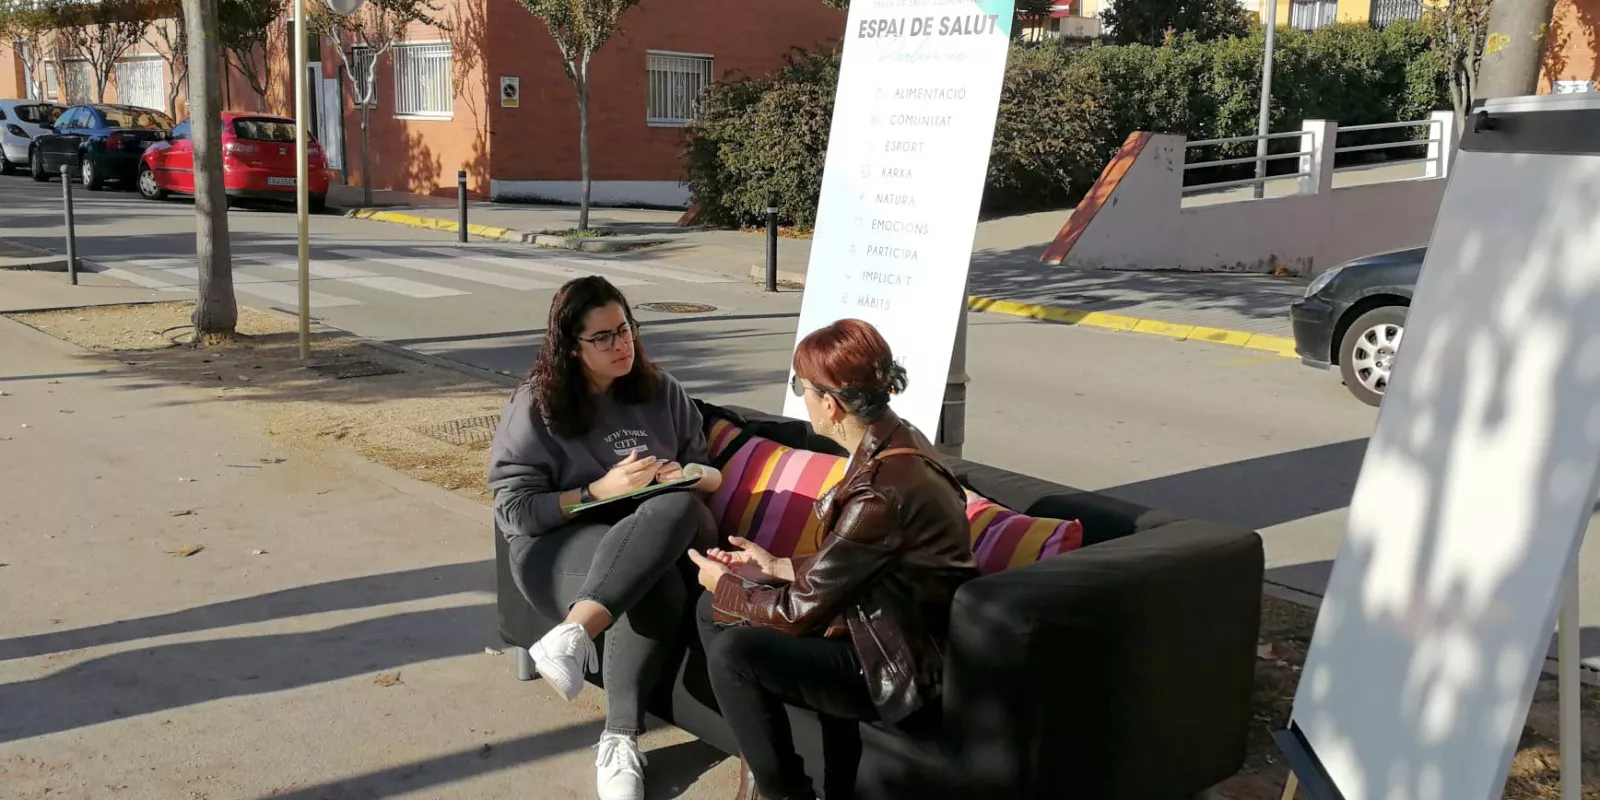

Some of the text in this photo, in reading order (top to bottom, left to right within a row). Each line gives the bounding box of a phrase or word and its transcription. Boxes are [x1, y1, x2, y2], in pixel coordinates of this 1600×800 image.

[858, 14, 999, 39] ESPAI DE SALUT
[894, 84, 966, 100] ALIMENTACIÓ
[889, 114, 952, 127] COMUNITAT
[885, 140, 925, 152] ESPORT
[881, 167, 912, 179] XARXA
[876, 193, 915, 206] NATURA
[871, 219, 929, 235] EMOCIONS
[866, 244, 918, 261] PARTICIPA
[622, 428, 649, 437] YORK
[614, 437, 638, 449] CITY
